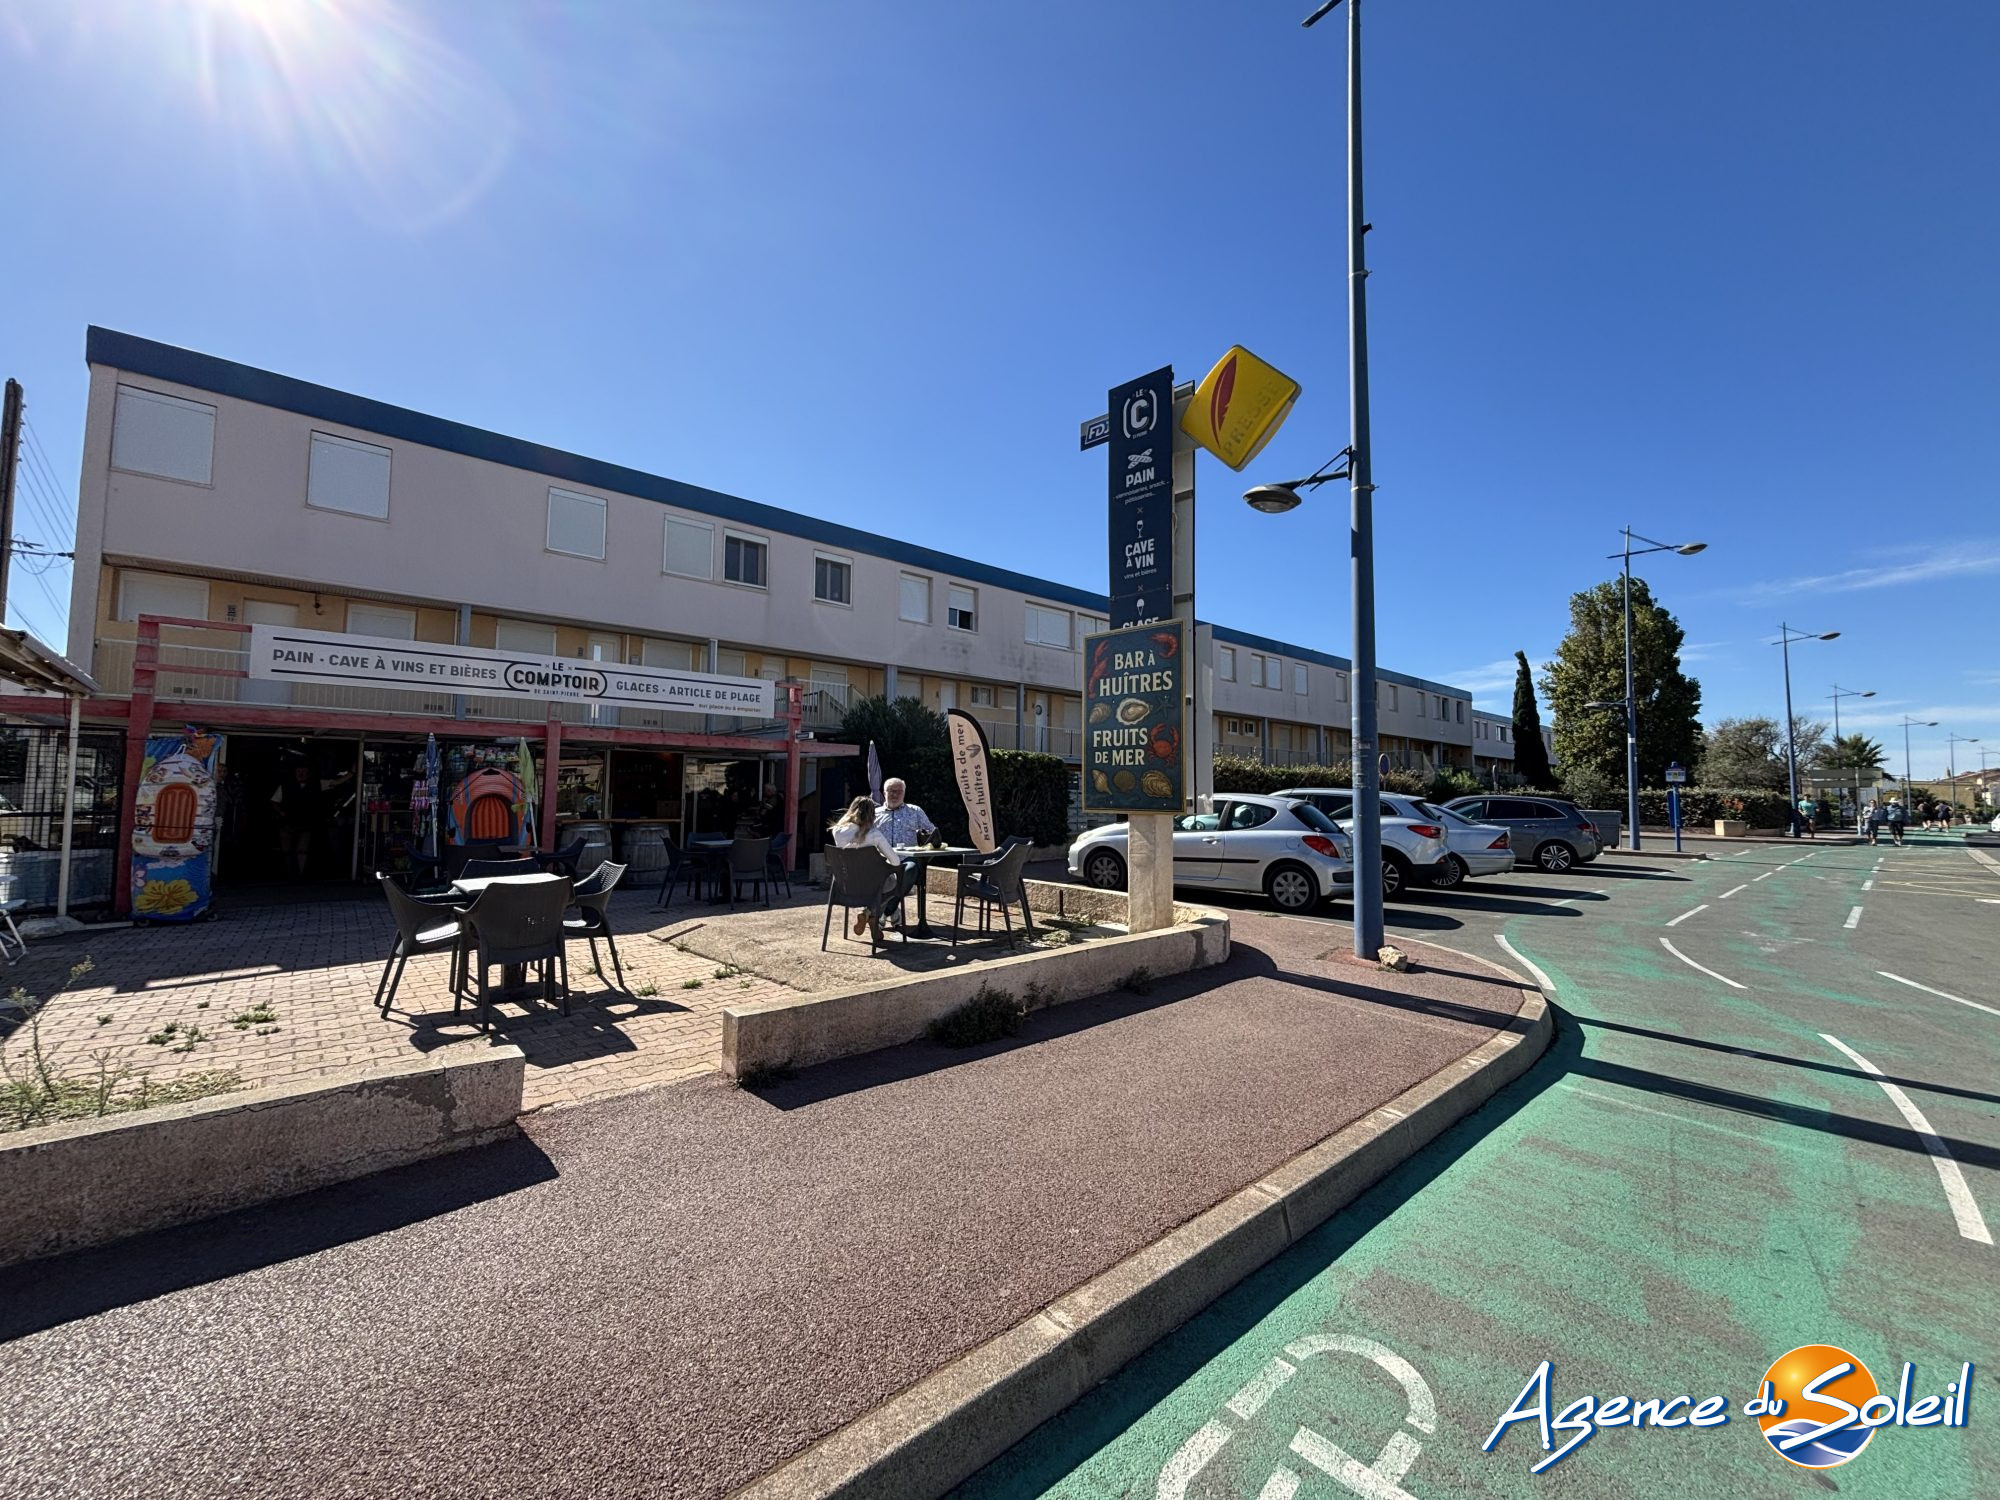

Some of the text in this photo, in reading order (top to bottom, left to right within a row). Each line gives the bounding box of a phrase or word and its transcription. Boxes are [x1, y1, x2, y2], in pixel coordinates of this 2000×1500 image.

[1135, 389, 1144, 398] LE
[1125, 467, 1155, 488] PAIN
[1125, 538, 1155, 557] CAVE
[1126, 553, 1154, 569] À VIN
[273, 649, 497, 680] PAIN CAVE À VINS ET BIÈRES
[552, 662, 564, 672] LE
[1114, 649, 1155, 671] BAR À
[513, 669, 600, 691] COMPTOIR
[1099, 670, 1173, 697] HUÎTRES
[616, 681, 761, 703] GLACES ARTICLE DE PLAGE
[957, 722, 965, 746] mer
[1093, 727, 1148, 748] FRUITS
[956, 748, 967, 765] de
[1094, 748, 1145, 766] DE MER
[974, 764, 985, 805] huîtres
[979, 809, 986, 817] à
